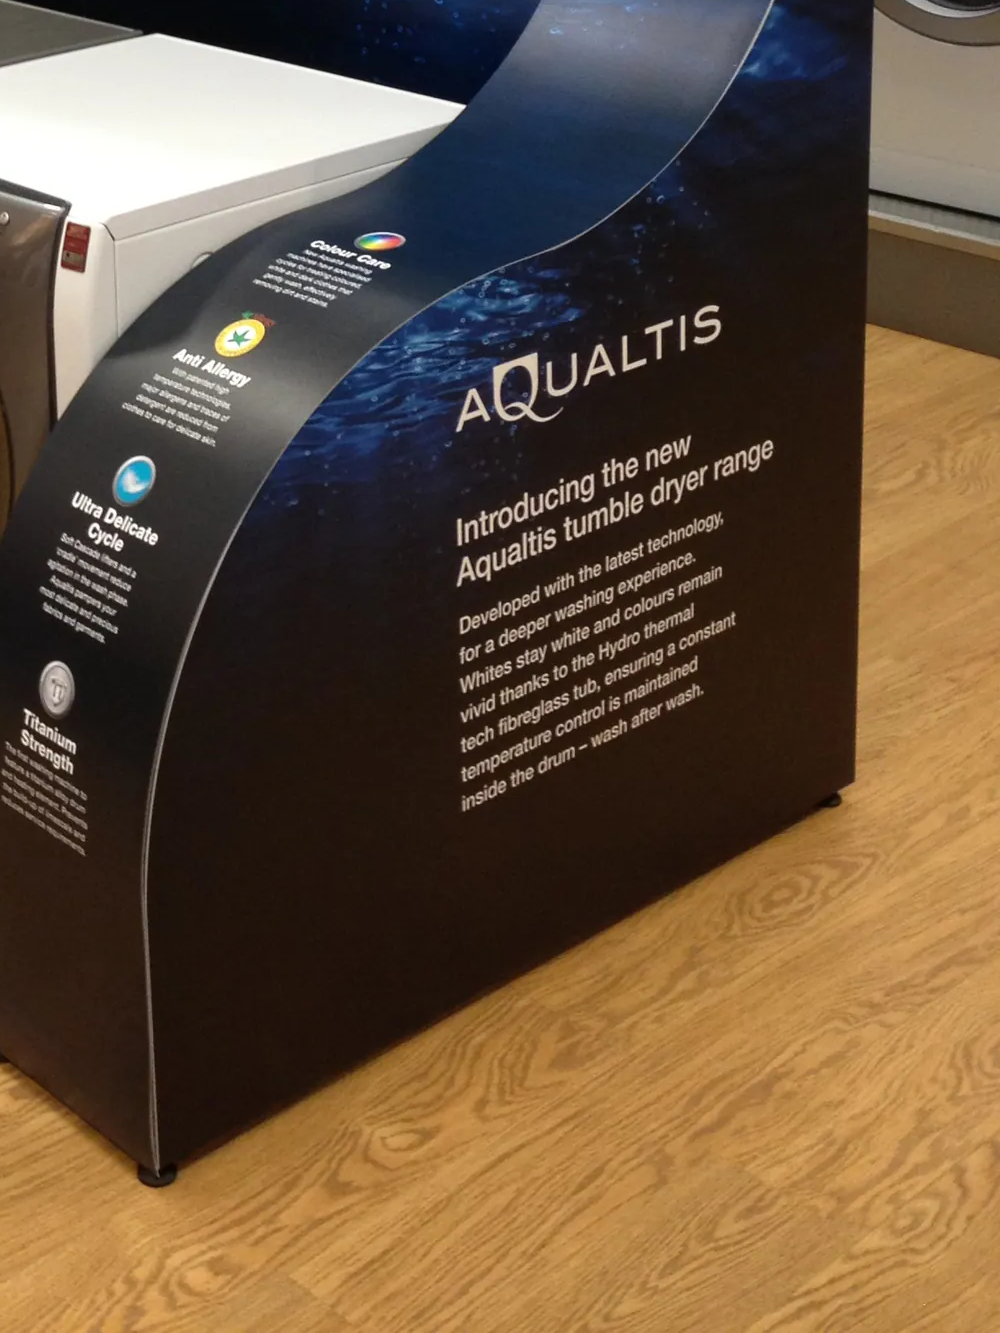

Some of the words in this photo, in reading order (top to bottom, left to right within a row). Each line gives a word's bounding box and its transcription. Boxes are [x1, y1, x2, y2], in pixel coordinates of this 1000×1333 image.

[310, 239, 357, 259] Colour
[356, 254, 392, 270] Care
[172, 348, 204, 368] Anti
[201, 359, 251, 388] Allergy
[455, 304, 722, 432] AQUALTIS
[71, 490, 103, 519] Ultra
[104, 506, 159, 547] Delicate
[87, 521, 125, 553] Cycle
[456, 474, 595, 545] Introducing
[600, 456, 639, 488] the
[645, 434, 692, 471] new
[456, 526, 557, 587] Aqualtis
[562, 491, 644, 541] tumble
[649, 465, 708, 506] dryer
[713, 439, 774, 480] range
[458, 585, 540, 635] Developed
[543, 572, 575, 598] with
[577, 562, 602, 583] the
[604, 541, 644, 572] latest
[646, 511, 724, 554] technology,
[458, 643, 482, 665] for
[483, 638, 496, 654] a
[497, 613, 552, 647] deeper
[553, 586, 615, 622] washing
[616, 552, 696, 595] experience.
[459, 660, 513, 693] Whites
[515, 644, 548, 669] stay
[550, 625, 591, 653] white
[592, 607, 621, 635] and
[623, 587, 675, 621] colours
[677, 565, 723, 596] remain
[459, 692, 496, 723] vivid
[498, 672, 550, 706] thanks
[551, 664, 569, 681] to
[570, 651, 596, 673] the
[597, 631, 641, 661] Hydro
[643, 602, 695, 639] thermal
[459, 725, 495, 753] tech
[497, 692, 570, 735] fibreglass
[572, 677, 601, 701] tub,
[603, 647, 664, 686] ensuring
[665, 642, 677, 657] a
[678, 611, 736, 650] constant
[460, 729, 552, 782] temperature
[554, 699, 606, 737] control
[607, 695, 621, 712] is
[623, 655, 699, 704] maintained
[20, 728, 74, 776] Strength
[22, 707, 77, 755] Titanium
[461, 779, 507, 812] inside
[509, 766, 535, 788] the
[536, 745, 576, 774] drum
[590, 718, 628, 748] wash
[630, 702, 663, 729] after
[664, 682, 704, 711] wash.
